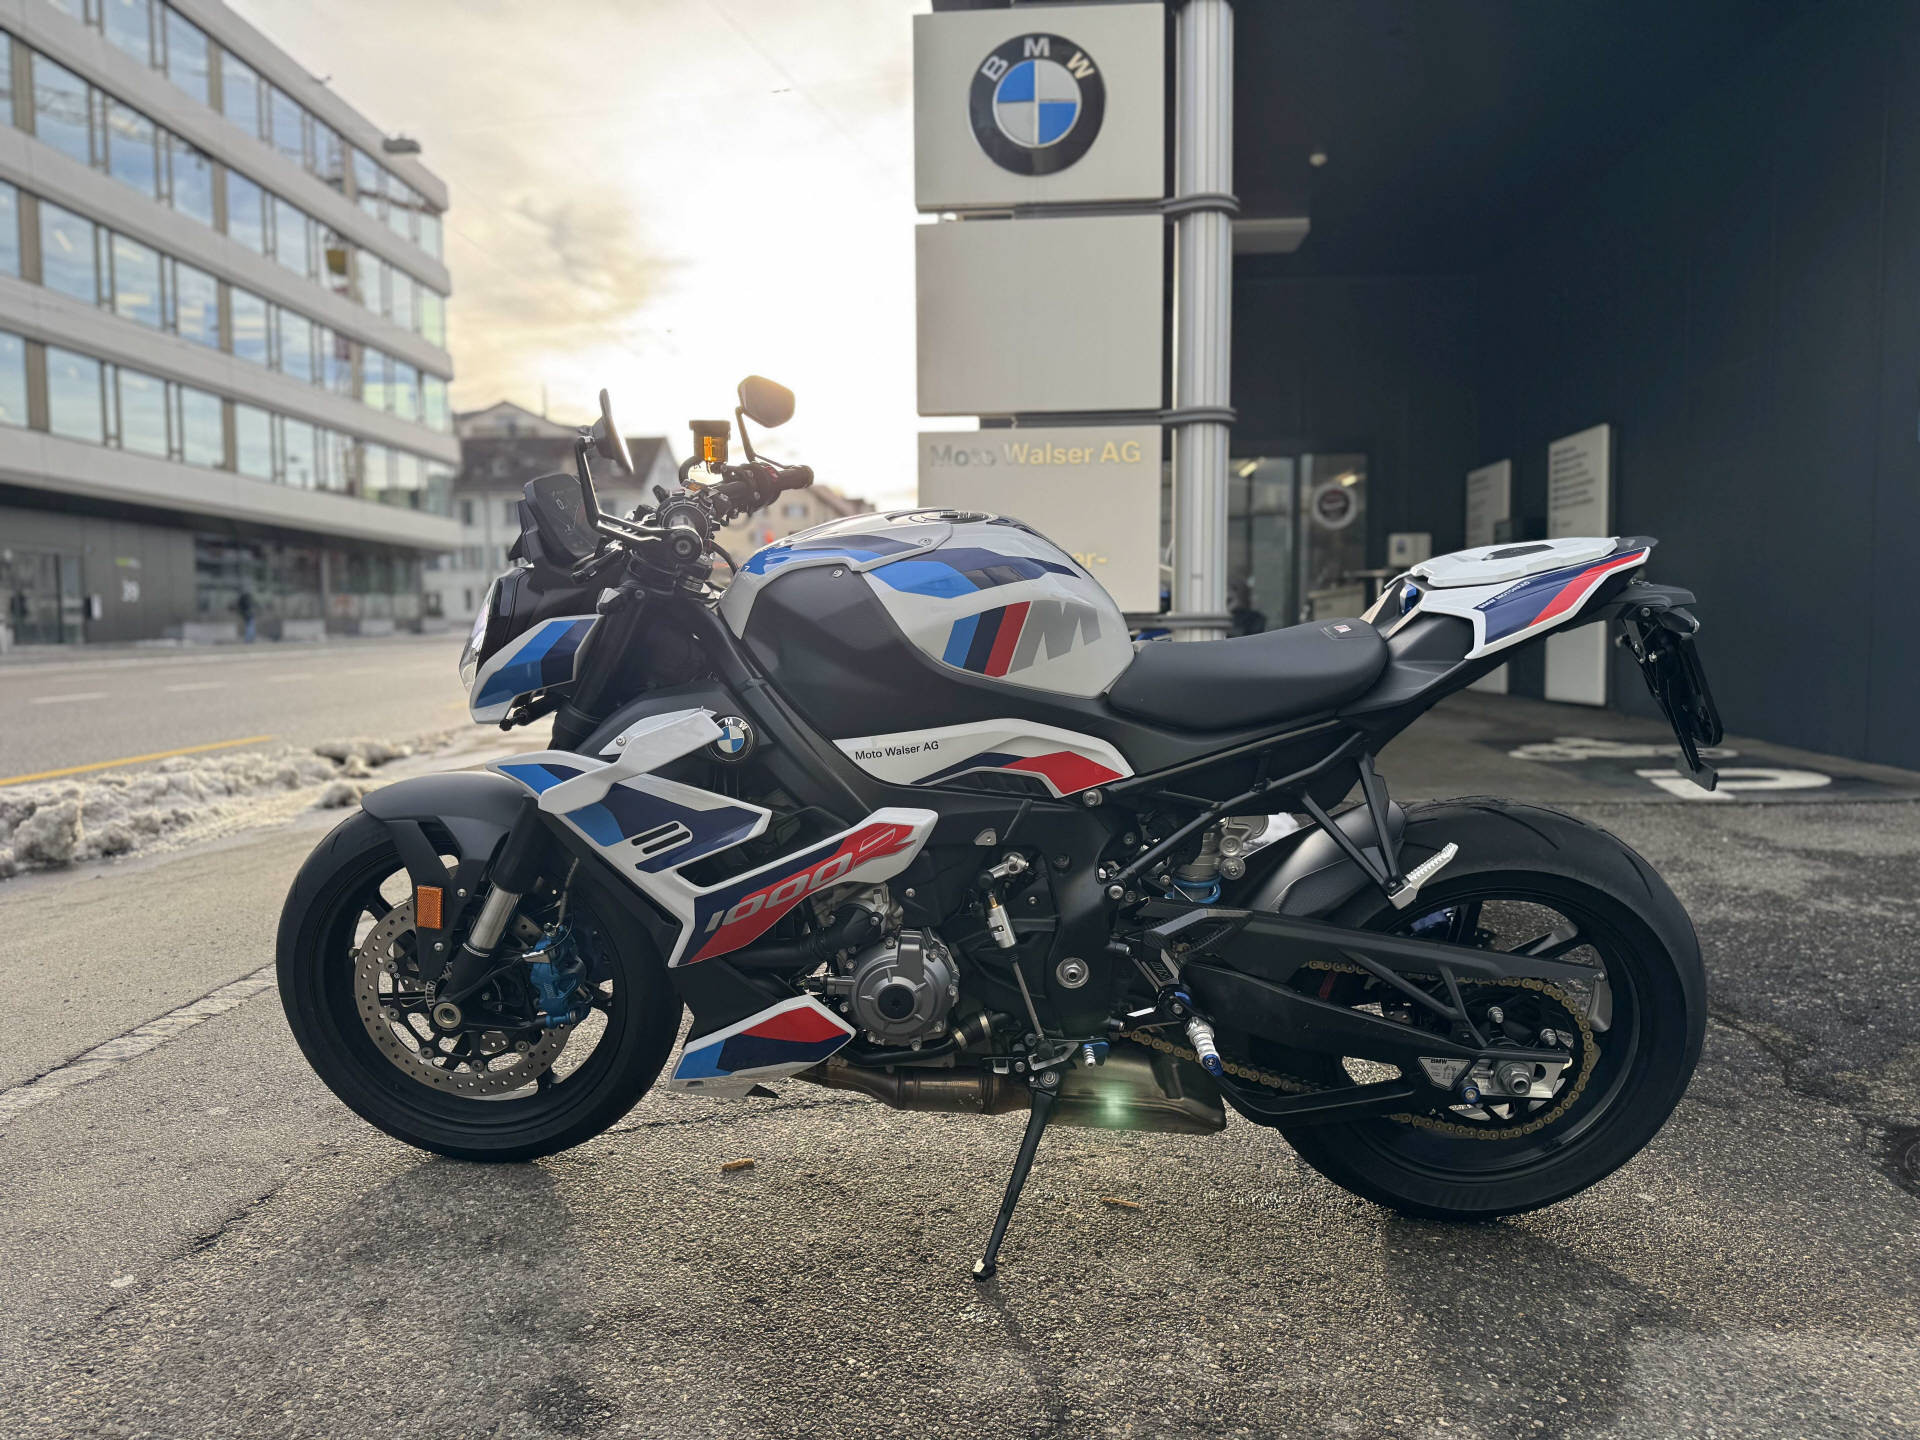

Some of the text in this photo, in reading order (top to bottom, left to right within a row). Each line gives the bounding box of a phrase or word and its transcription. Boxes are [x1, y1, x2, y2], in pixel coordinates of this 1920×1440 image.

[981, 37, 1095, 82] BMW
[929, 440, 1142, 468] Moto Walser AG
[724, 718, 748, 731] MW
[855, 740, 939, 760] Moto Walser AG
